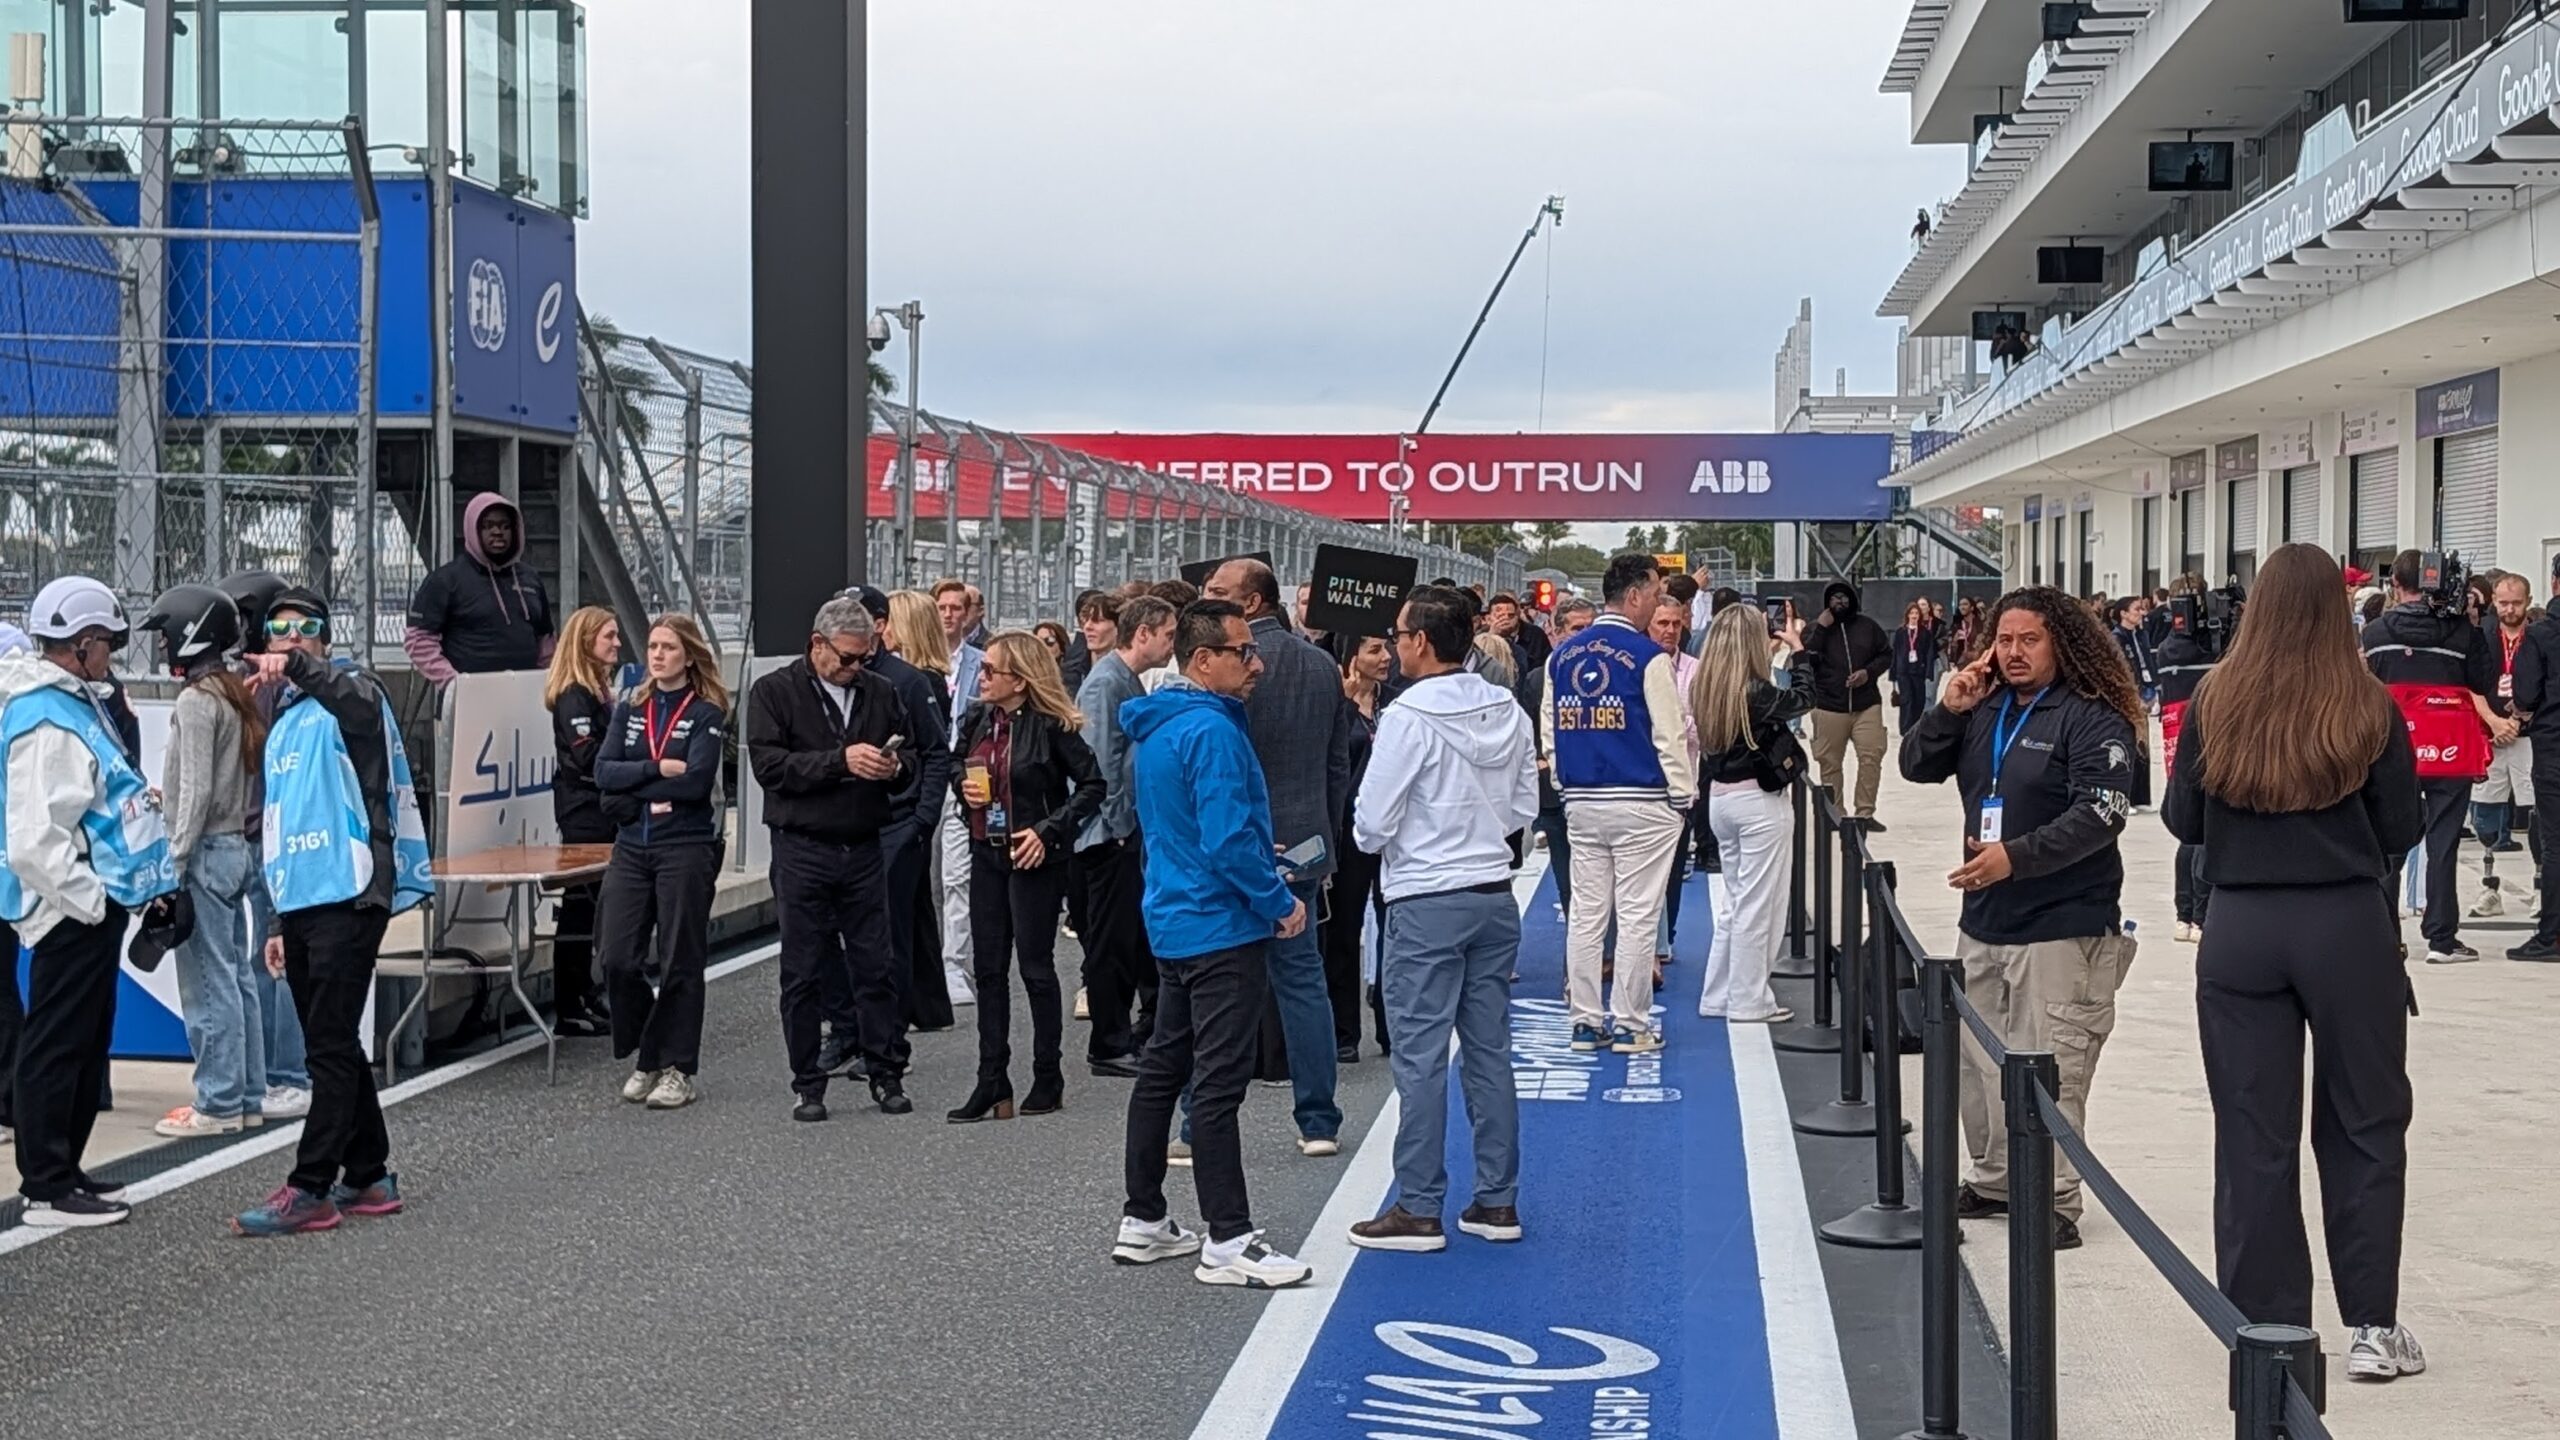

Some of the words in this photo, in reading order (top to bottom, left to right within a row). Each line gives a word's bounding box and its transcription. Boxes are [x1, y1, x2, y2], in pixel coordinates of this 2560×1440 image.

[2499, 44, 2552, 127] Google
[2446, 87, 2480, 157] Cloud
[1346, 462, 1415, 492] TO
[1428, 462, 1643, 492] OUTRUN
[1689, 460, 1772, 493] ABB
[1327, 590, 1373, 609] WALK
[1328, 575, 1399, 599] PITLANE
